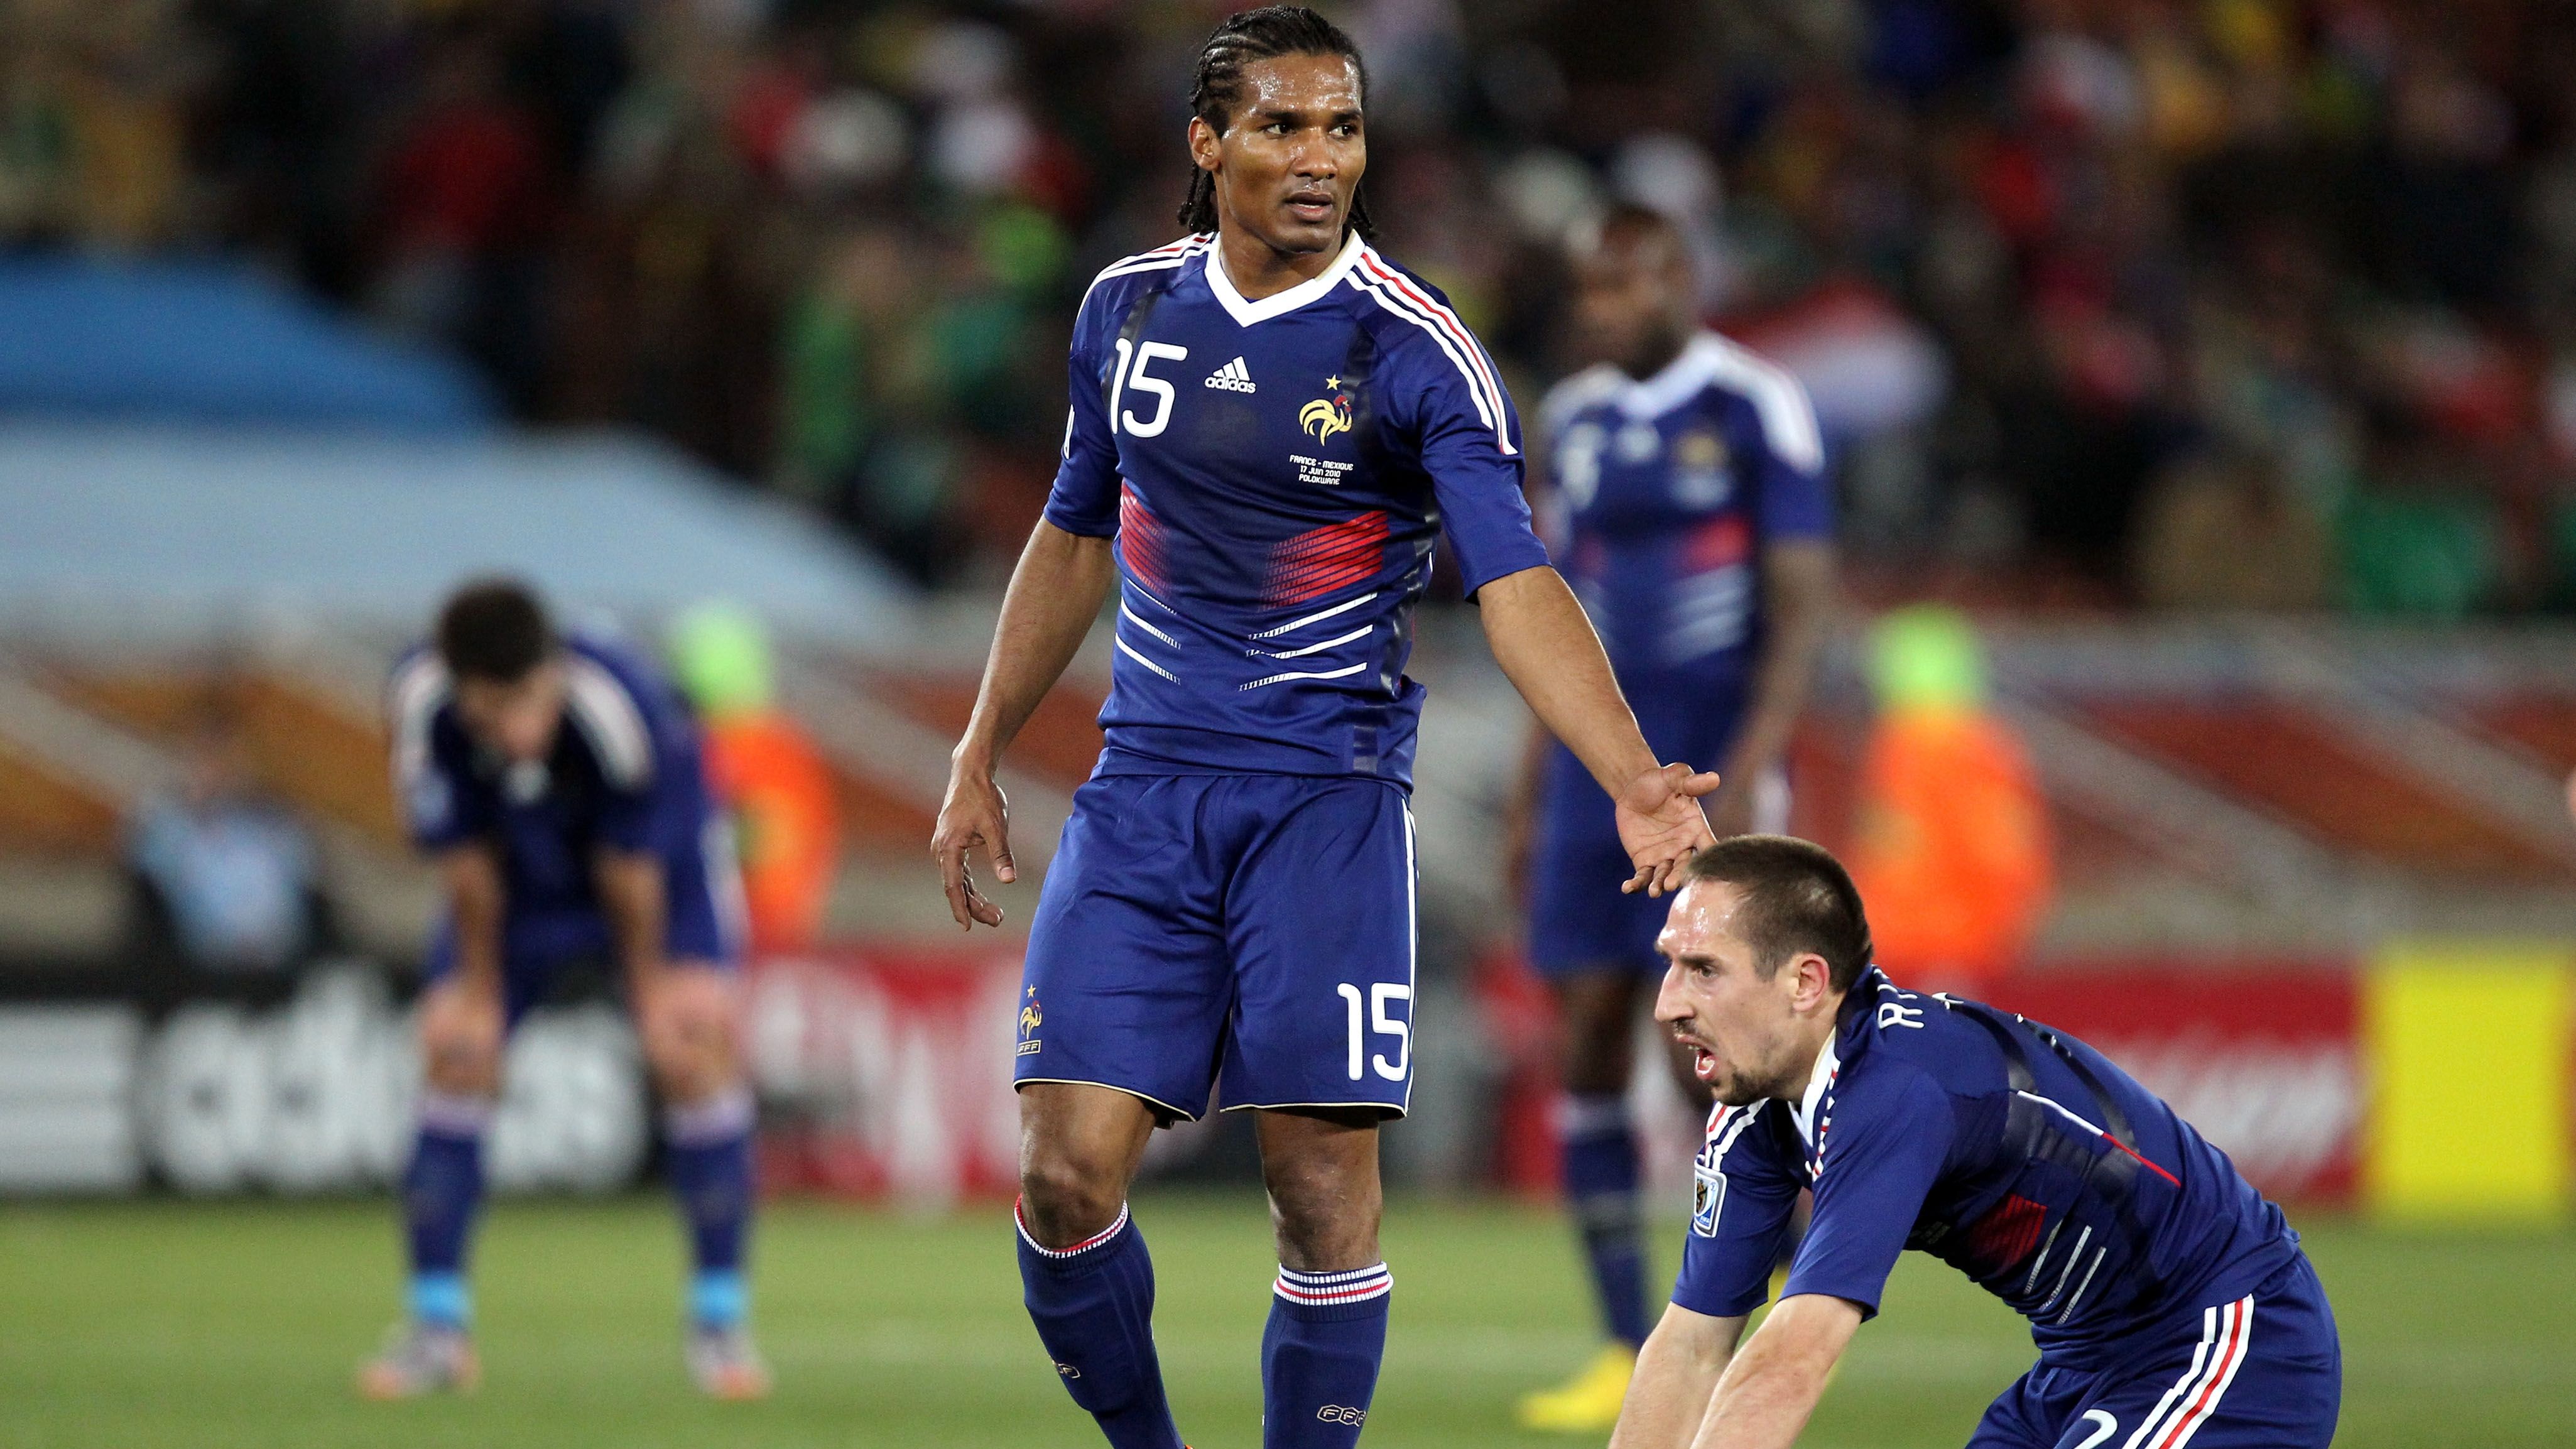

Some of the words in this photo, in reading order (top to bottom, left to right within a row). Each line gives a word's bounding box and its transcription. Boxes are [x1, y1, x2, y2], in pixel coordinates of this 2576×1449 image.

[1110, 337, 1188, 438] 15
[1204, 376, 1256, 394] adidas
[1289, 455, 1317, 467] FRANCE
[1322, 460, 1354, 471] MEXIQUE
[1298, 474, 1340, 486] POLOKWANE
[1308, 467, 1324, 476] JUIN
[1325, 469, 1341, 477] 2010
[1337, 982, 1411, 1082] 15
